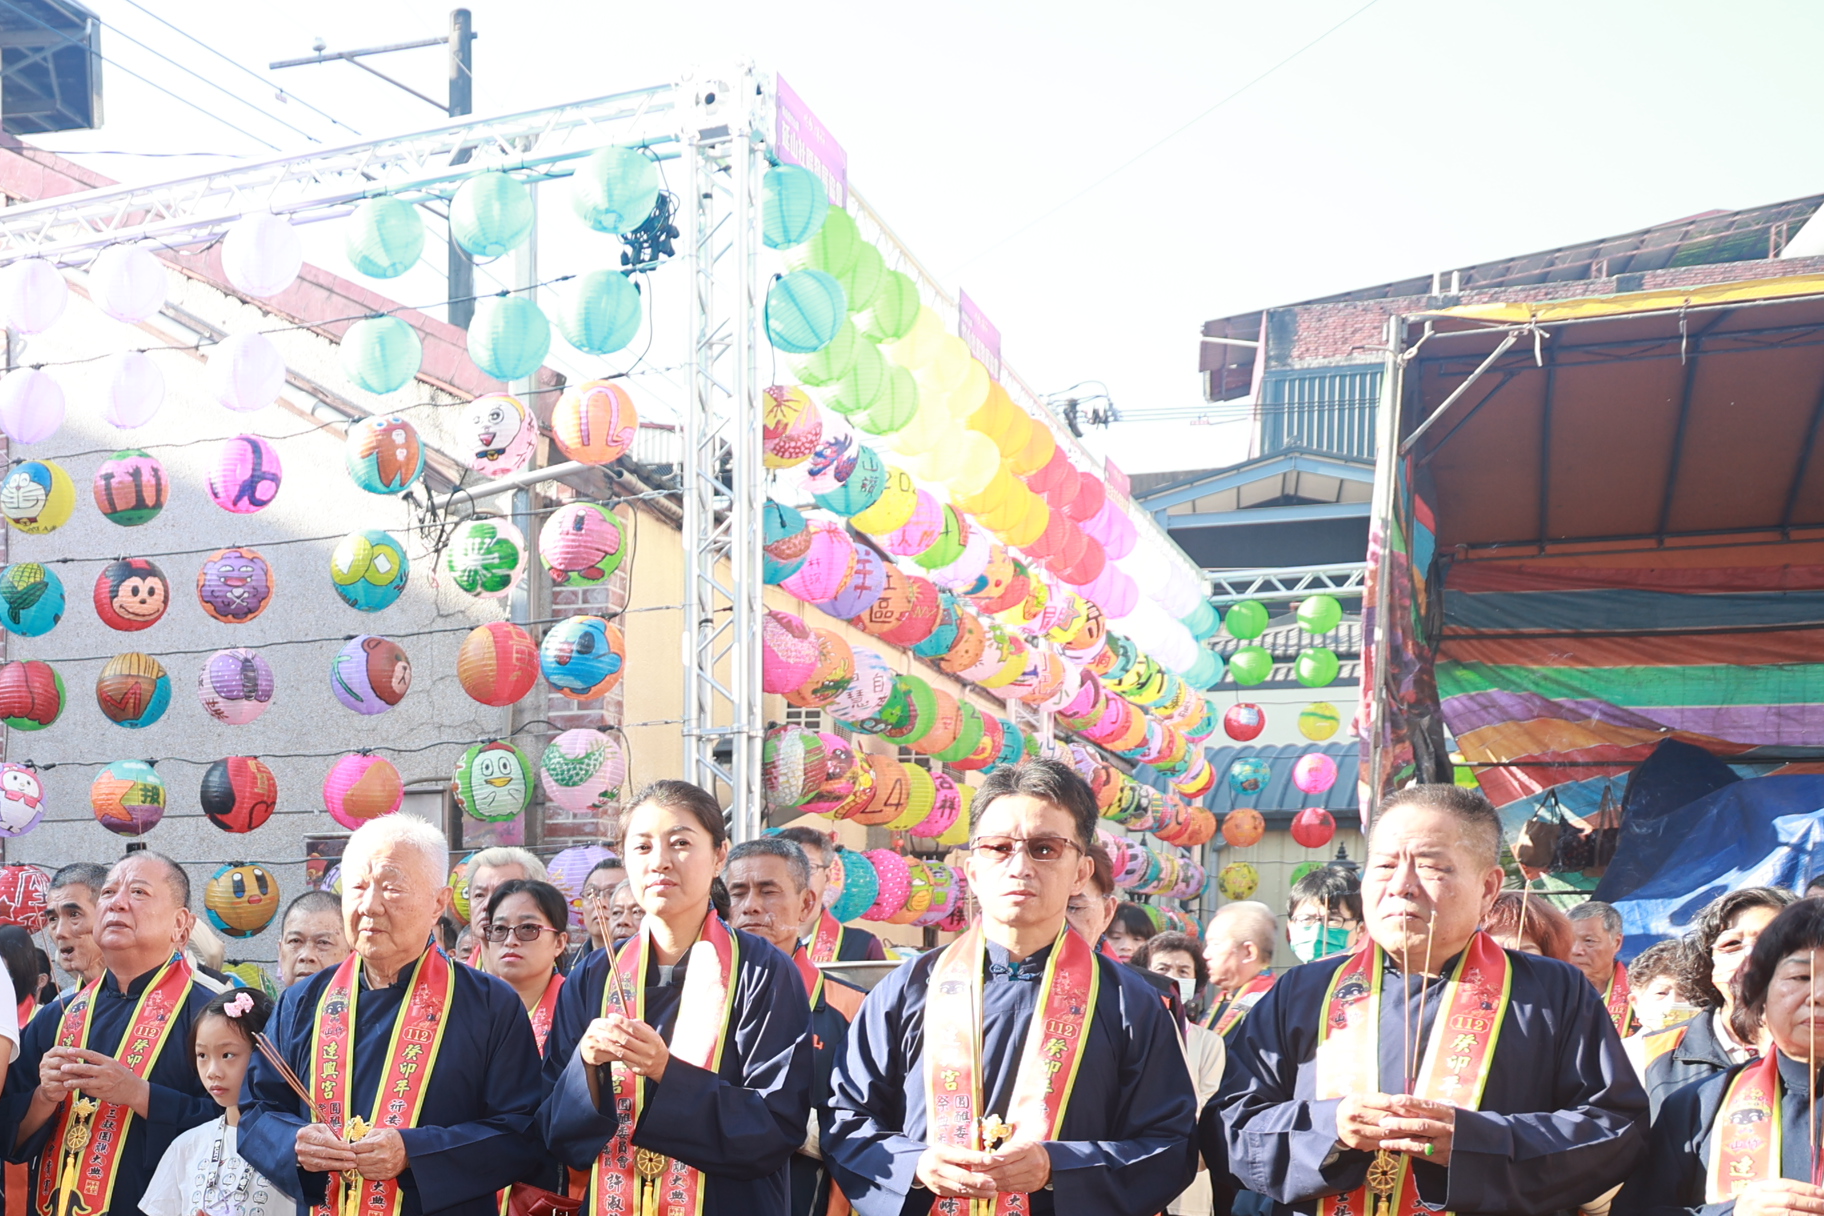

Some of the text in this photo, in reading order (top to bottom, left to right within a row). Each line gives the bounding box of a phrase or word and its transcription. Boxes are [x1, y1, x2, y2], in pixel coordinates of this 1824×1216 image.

[136, 1026, 158, 1037] 112
[406, 1028, 430, 1041] 112
[1041, 1020, 1074, 1096] 112 癸卯年
[1438, 1017, 1484, 1098] 112 癸卯年
[320, 1042, 340, 1099] 連興宮
[393, 1043, 423, 1098] 癸卯年
